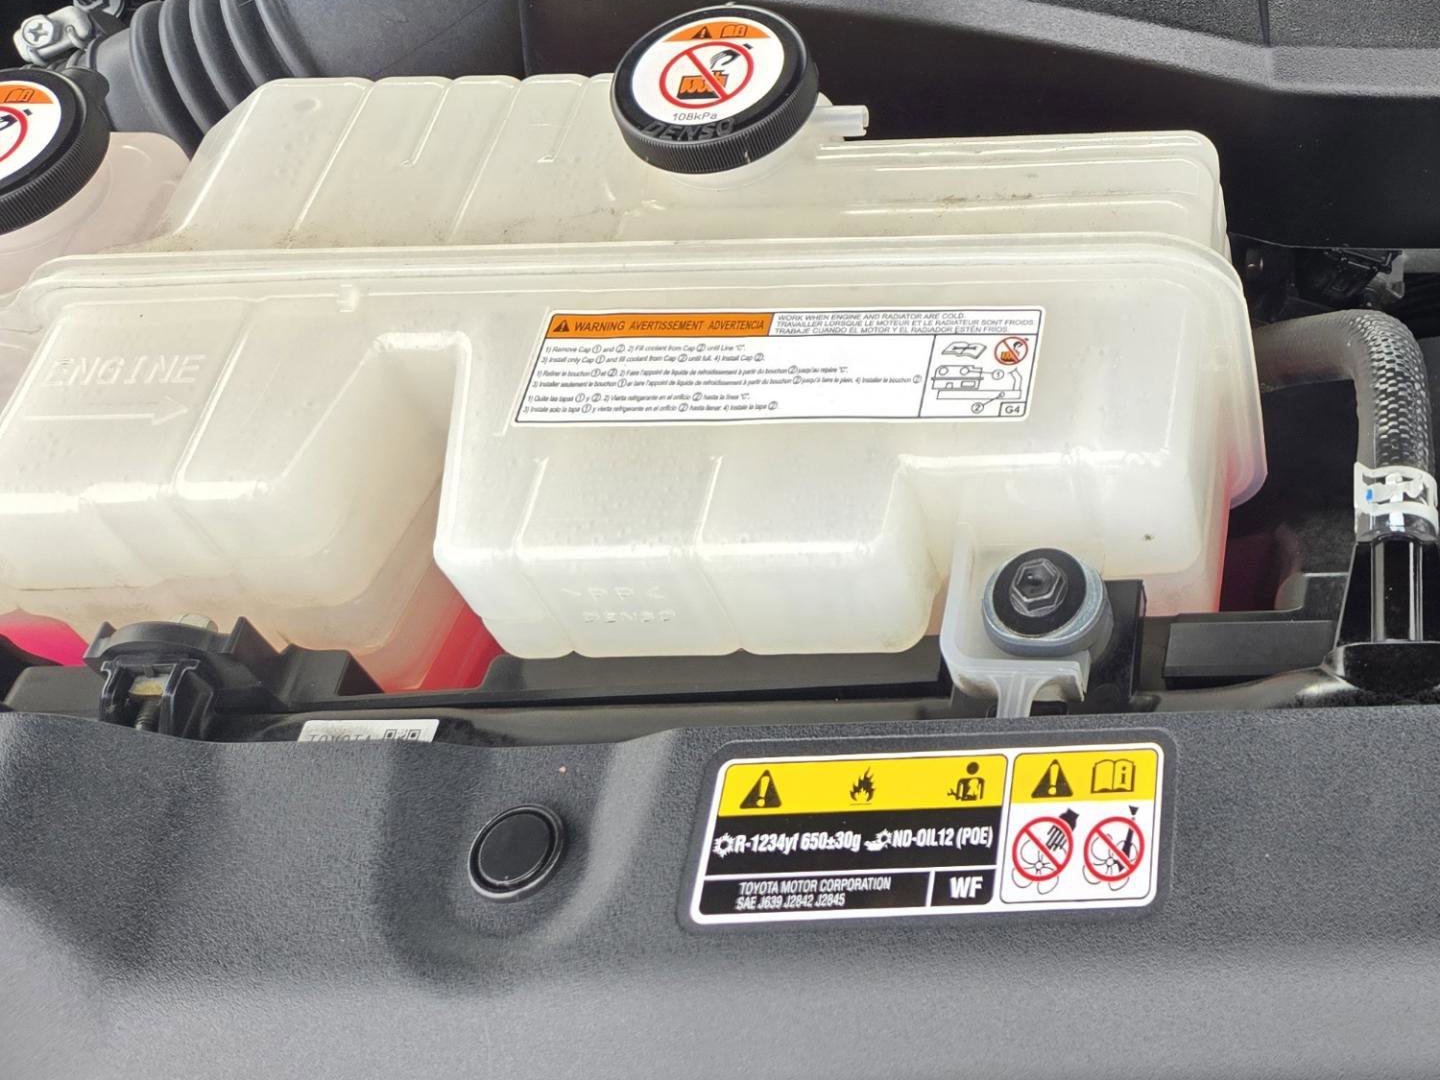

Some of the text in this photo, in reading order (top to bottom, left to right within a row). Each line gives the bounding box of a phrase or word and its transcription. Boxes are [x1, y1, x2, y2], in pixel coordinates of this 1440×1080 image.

[672, 111, 719, 122] 108kPa
[642, 119, 736, 142] DENSO
[575, 320, 764, 331] WARNING AVERTISSEMENT ADVERTENCIA
[42, 354, 208, 386] ENGINE
[1005, 405, 1020, 414] G4
[734, 826, 993, 855] R-1234yf 650±30g ND-OIL12 (POE)
[739, 876, 892, 895] TOYOTA MOTOR CORPORATION
[949, 876, 983, 900] WF
[735, 893, 846, 910] SAE J639 J2842 J2845
